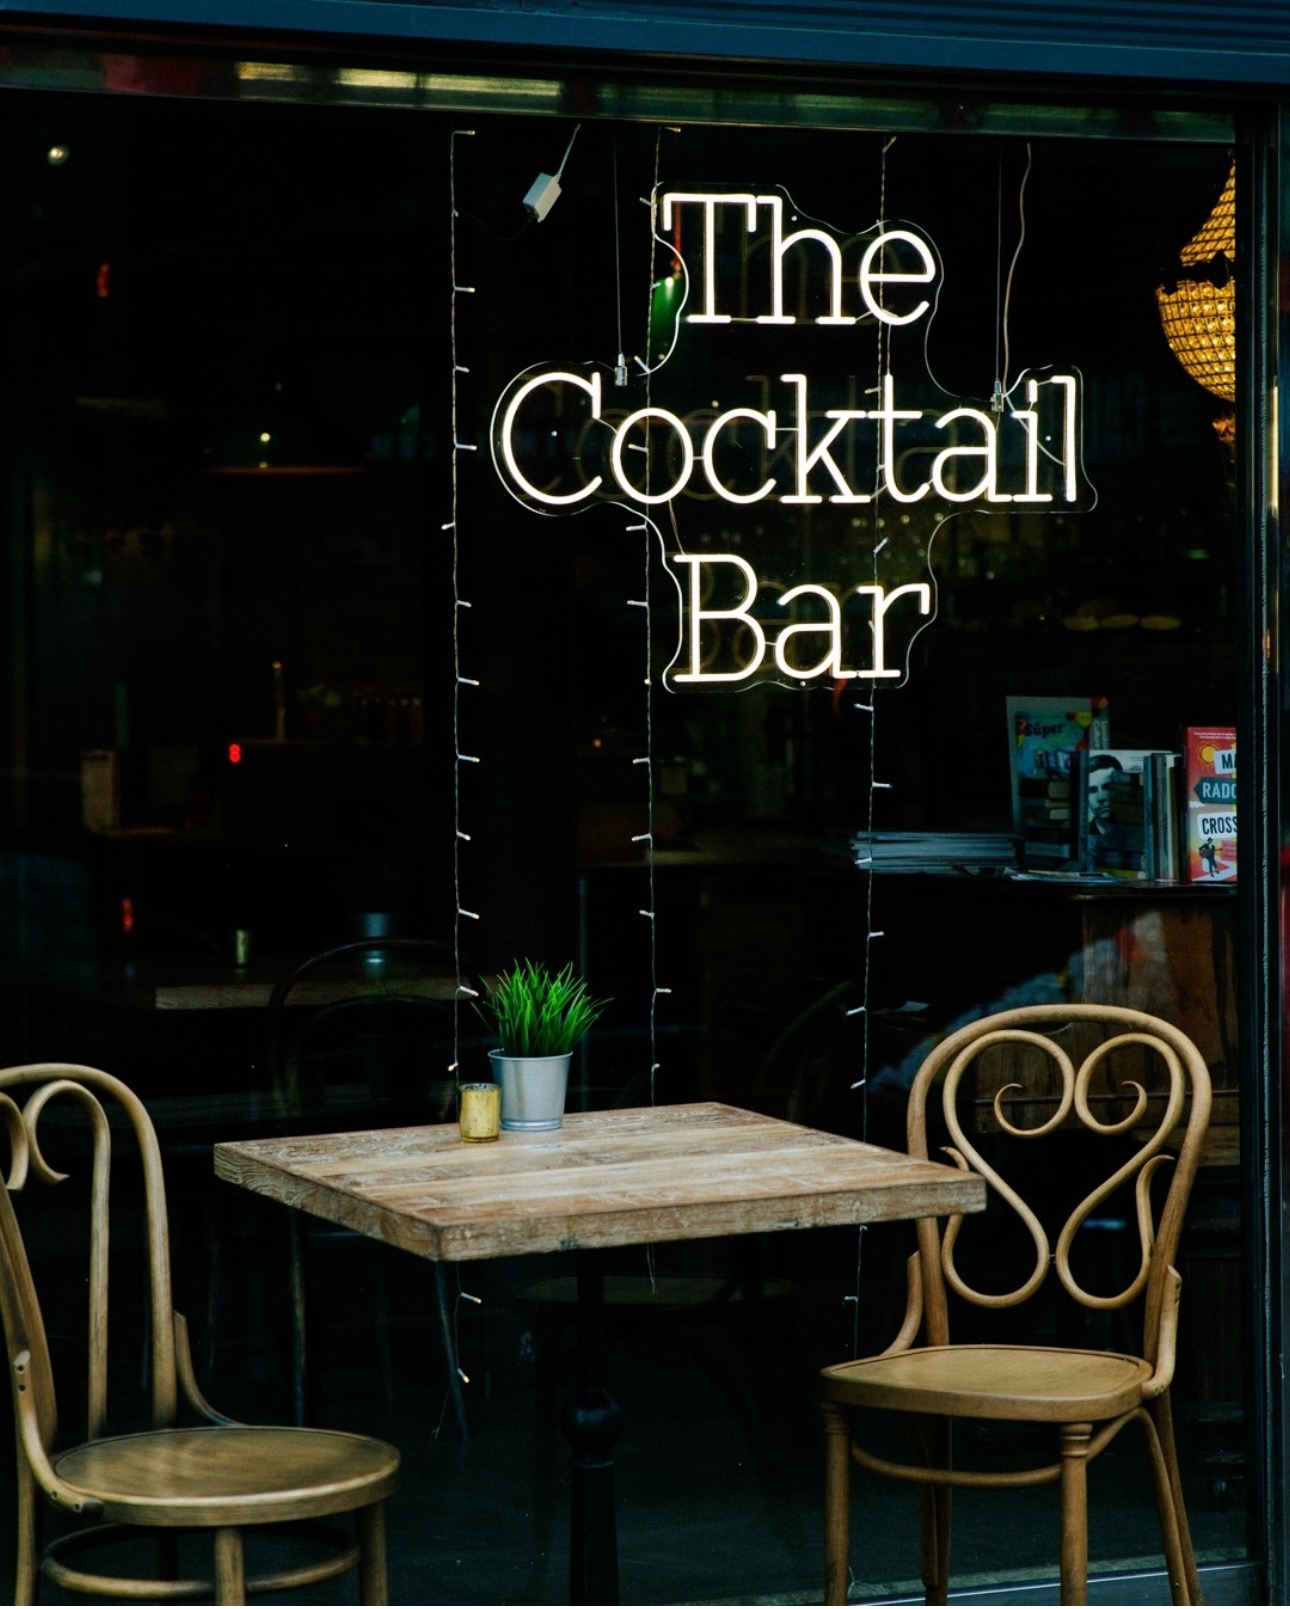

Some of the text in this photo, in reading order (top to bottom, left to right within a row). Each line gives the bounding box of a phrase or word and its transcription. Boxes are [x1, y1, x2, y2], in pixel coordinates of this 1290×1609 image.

[663, 192, 937, 326] The
[502, 371, 1077, 505] Cocktail
[672, 553, 931, 683] Bar
[1202, 816, 1238, 835] CROSS
